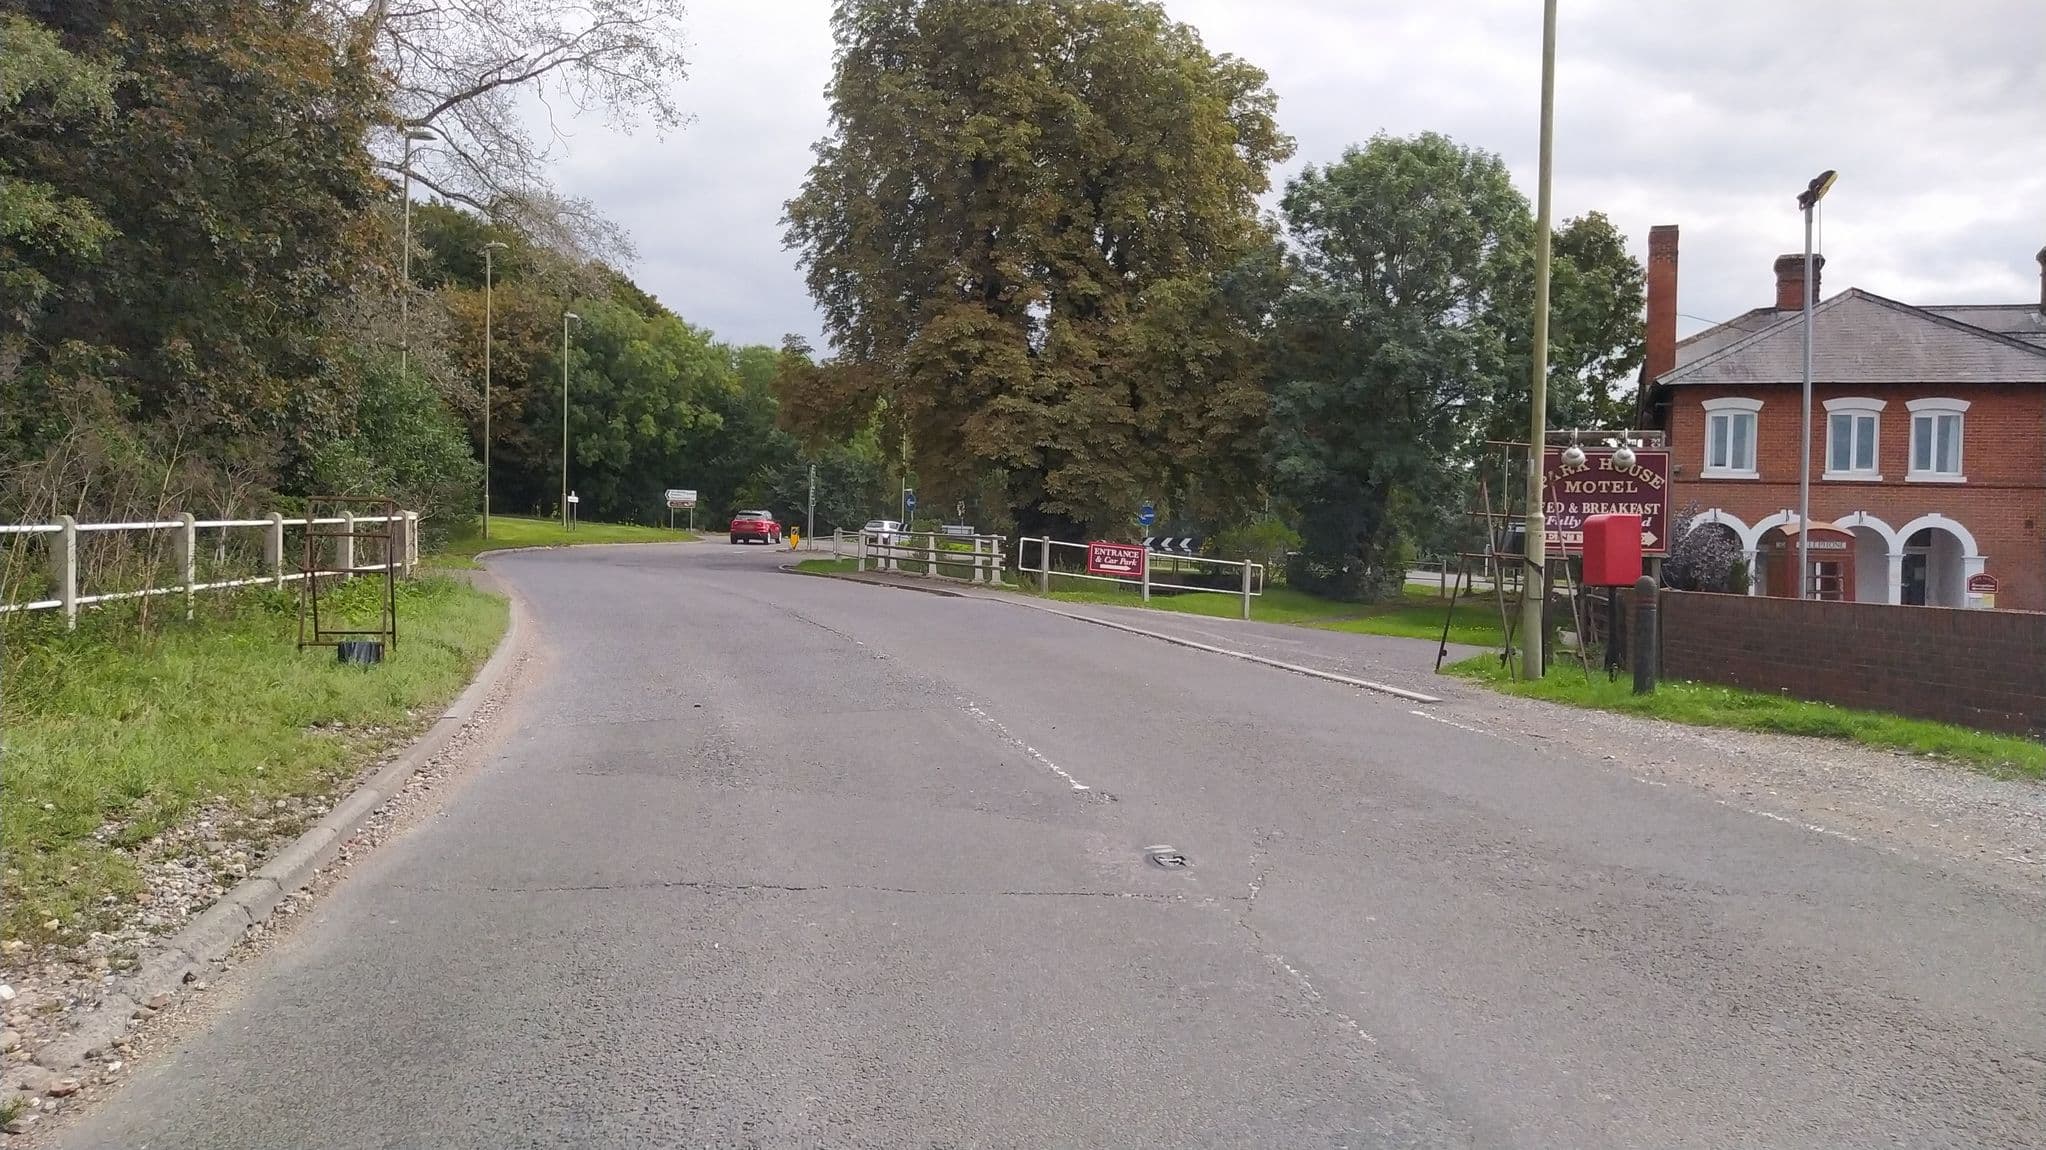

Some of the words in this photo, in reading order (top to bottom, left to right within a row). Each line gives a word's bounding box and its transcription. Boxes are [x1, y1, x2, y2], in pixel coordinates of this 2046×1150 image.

[1565, 481, 1638, 494] MOTEL
[1541, 501, 1565, 514] ED
[1569, 502, 1579, 514] &
[1582, 502, 1660, 515] BREAKFAST
[1094, 548, 1140, 559] ENTRANCE
[1104, 556, 1119, 564] Car
[1120, 557, 1138, 566] Park
